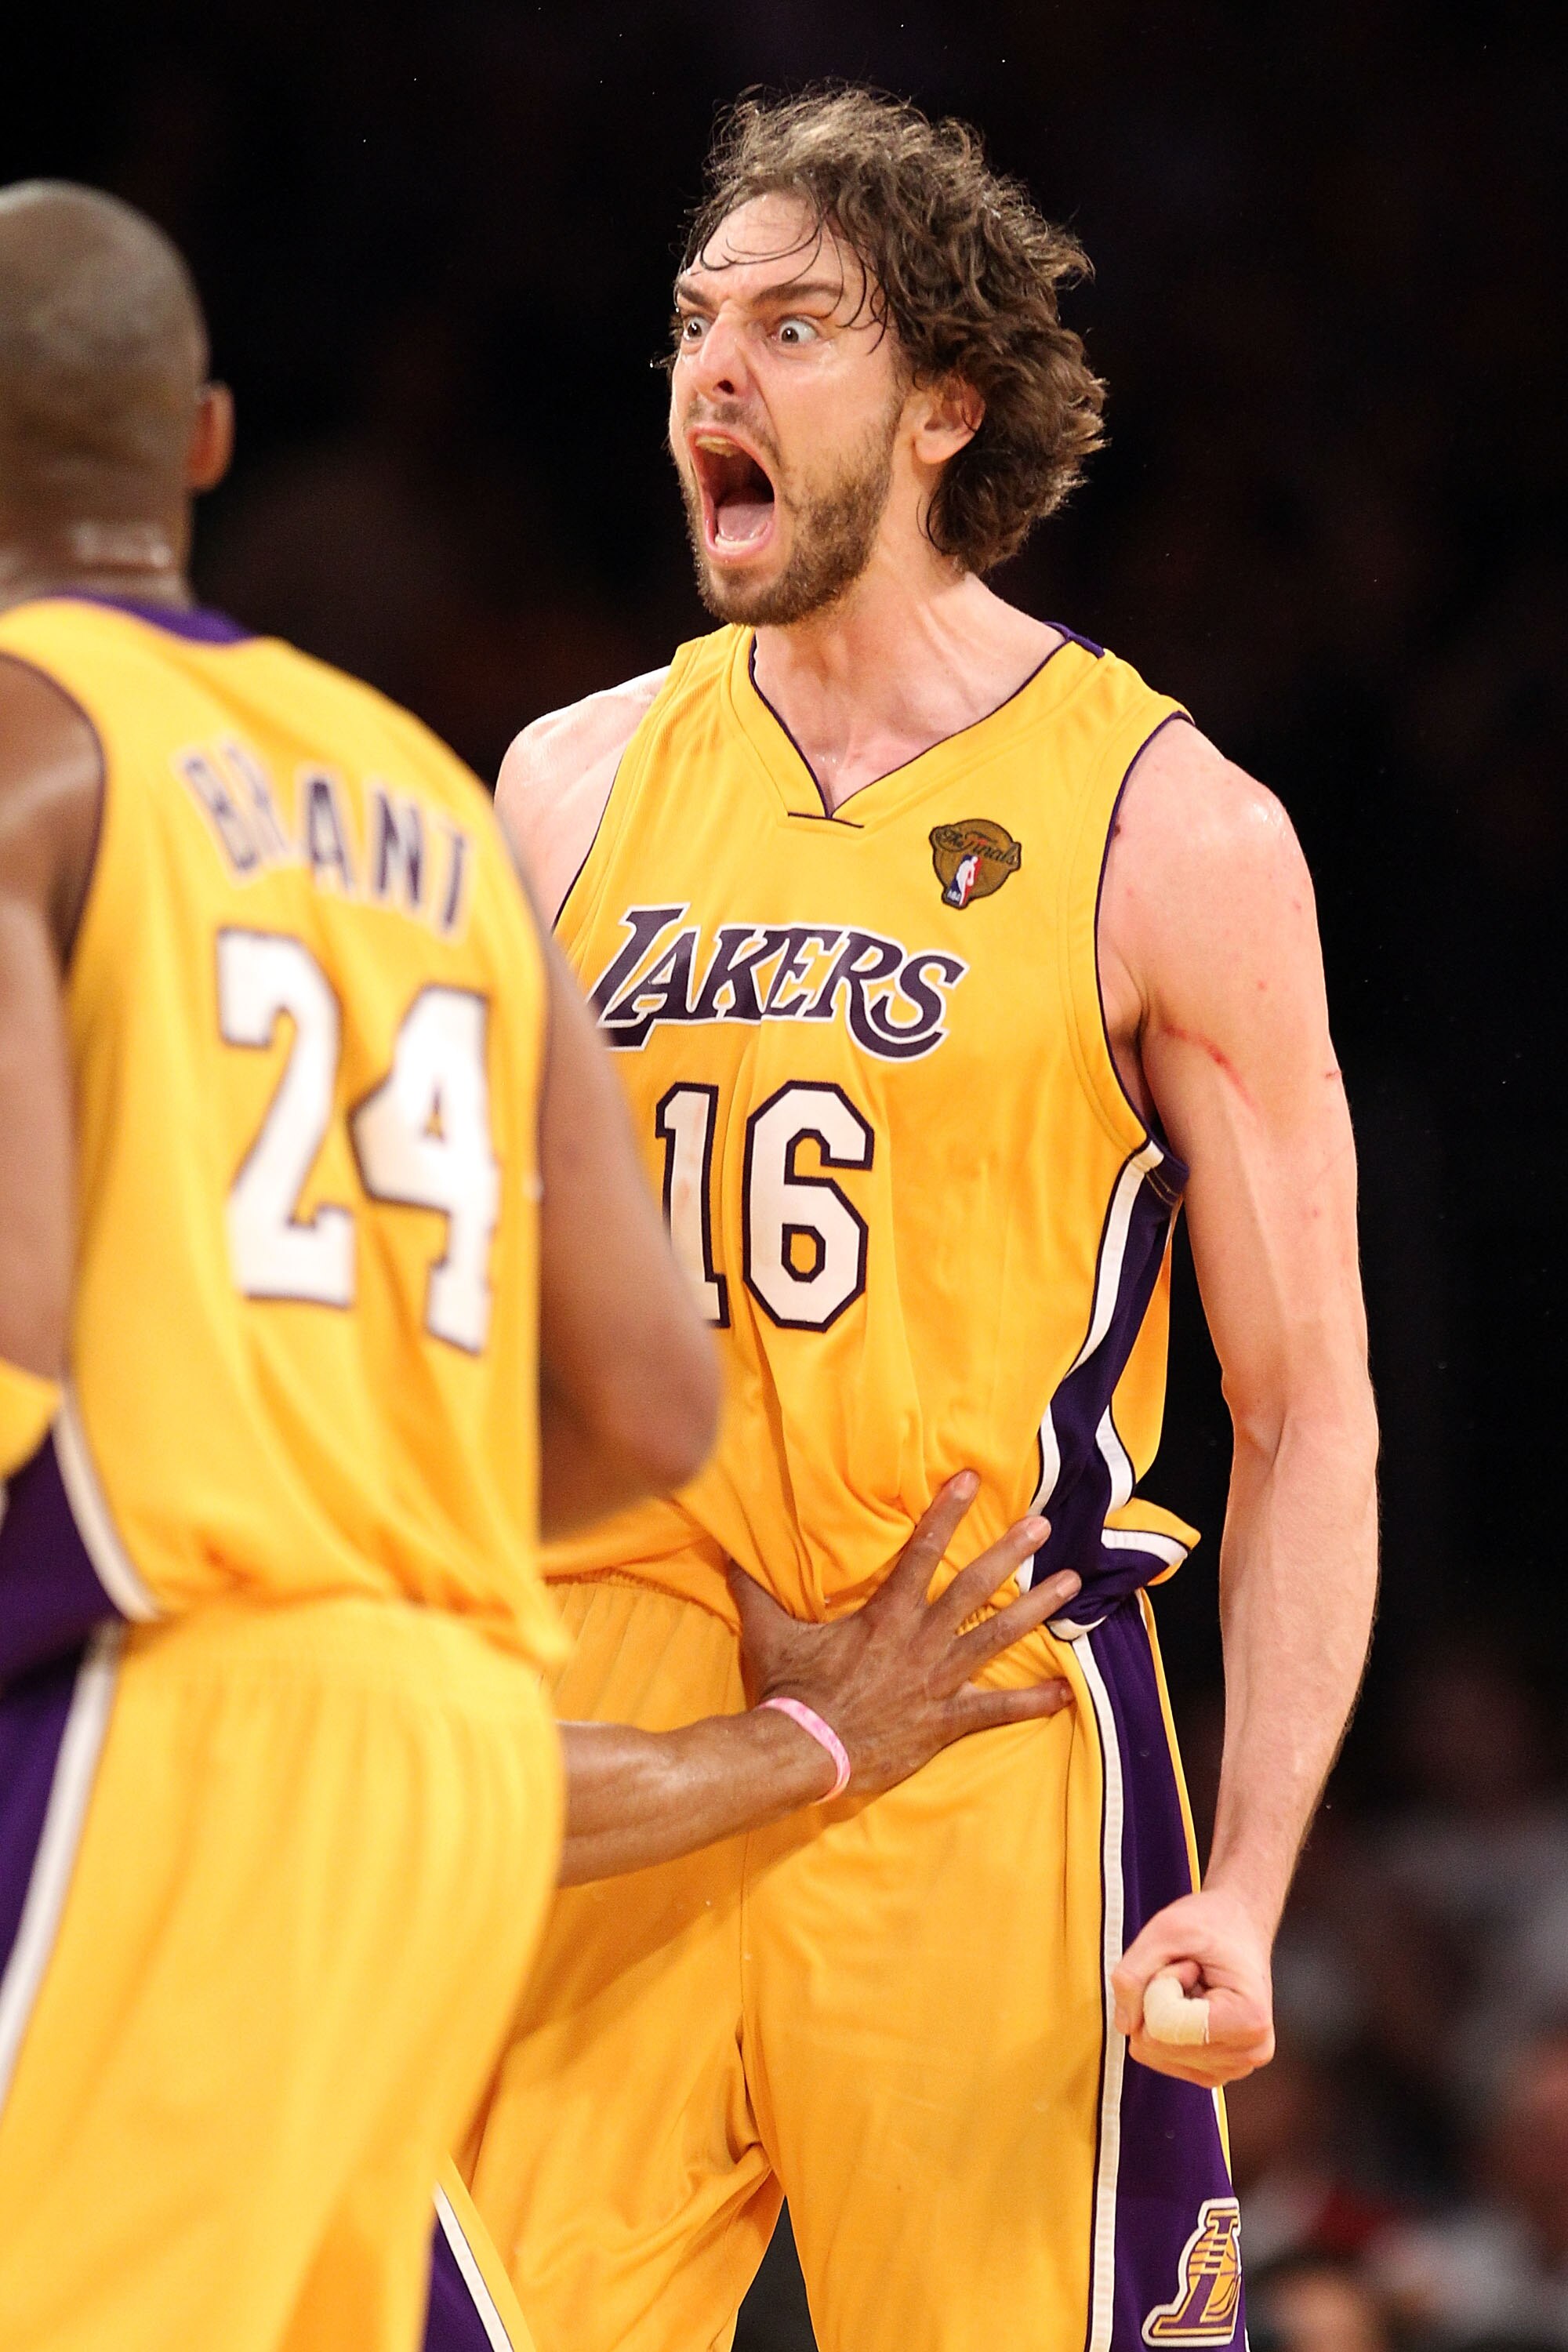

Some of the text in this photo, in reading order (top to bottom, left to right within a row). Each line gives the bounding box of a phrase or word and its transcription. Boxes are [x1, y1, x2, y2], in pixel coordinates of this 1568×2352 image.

[176, 739, 469, 941] BRANT
[586, 903, 969, 1062] LAKERS
[216, 927, 502, 1357] 24
[655, 1080, 874, 1333] 16
